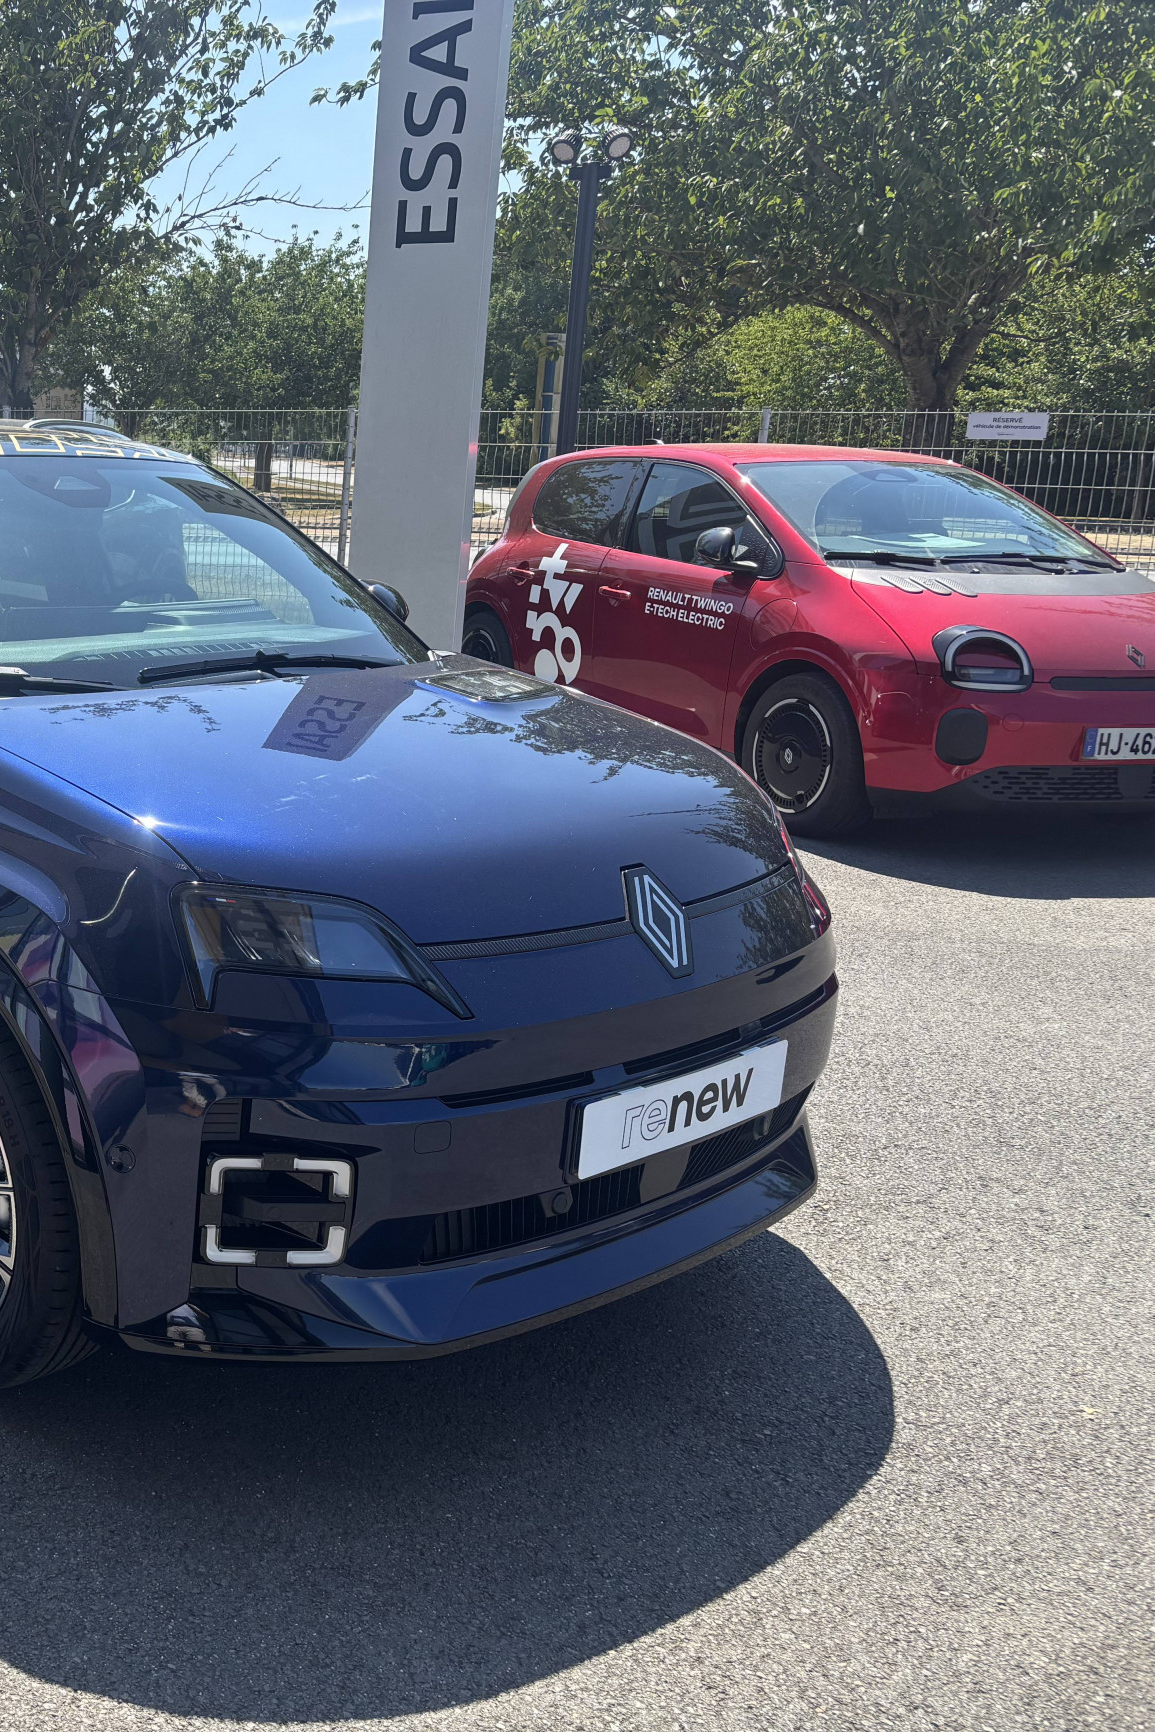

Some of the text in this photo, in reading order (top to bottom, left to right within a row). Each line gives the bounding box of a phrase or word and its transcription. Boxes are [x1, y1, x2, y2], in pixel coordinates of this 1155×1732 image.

[648, 587, 734, 614] RENAULT TWINGO
[644, 602, 726, 630] E-TECH ELECTRIC
[2, 1110, 14, 1128] 18
[621, 1068, 754, 1150] renew
